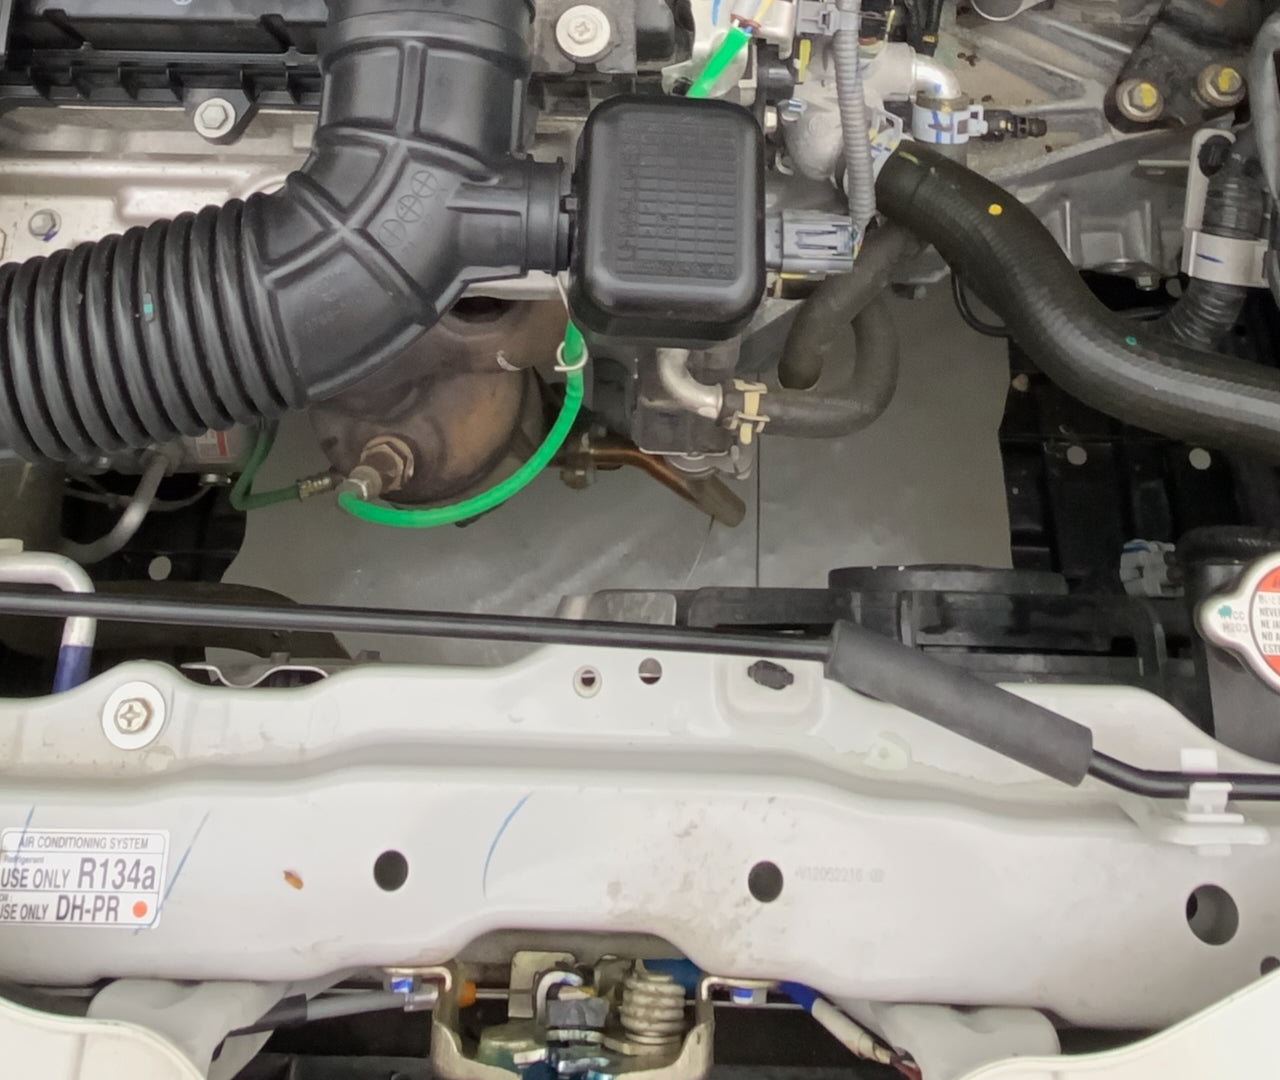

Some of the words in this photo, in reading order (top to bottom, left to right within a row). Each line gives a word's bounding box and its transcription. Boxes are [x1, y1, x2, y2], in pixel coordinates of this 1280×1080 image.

[1261, 620, 1270, 629] NE
[1262, 631, 1273, 641] NO
[19, 836, 35, 848] AIR
[38, 836, 107, 849] CONDITIONING
[110, 837, 149, 849] SYSTEM
[0, 868, 29, 888] USE
[32, 868, 70, 889] ONLY
[77, 857, 156, 890] R134a
[20, 904, 49, 920] ONLY
[56, 895, 120, 921] DH-PR
